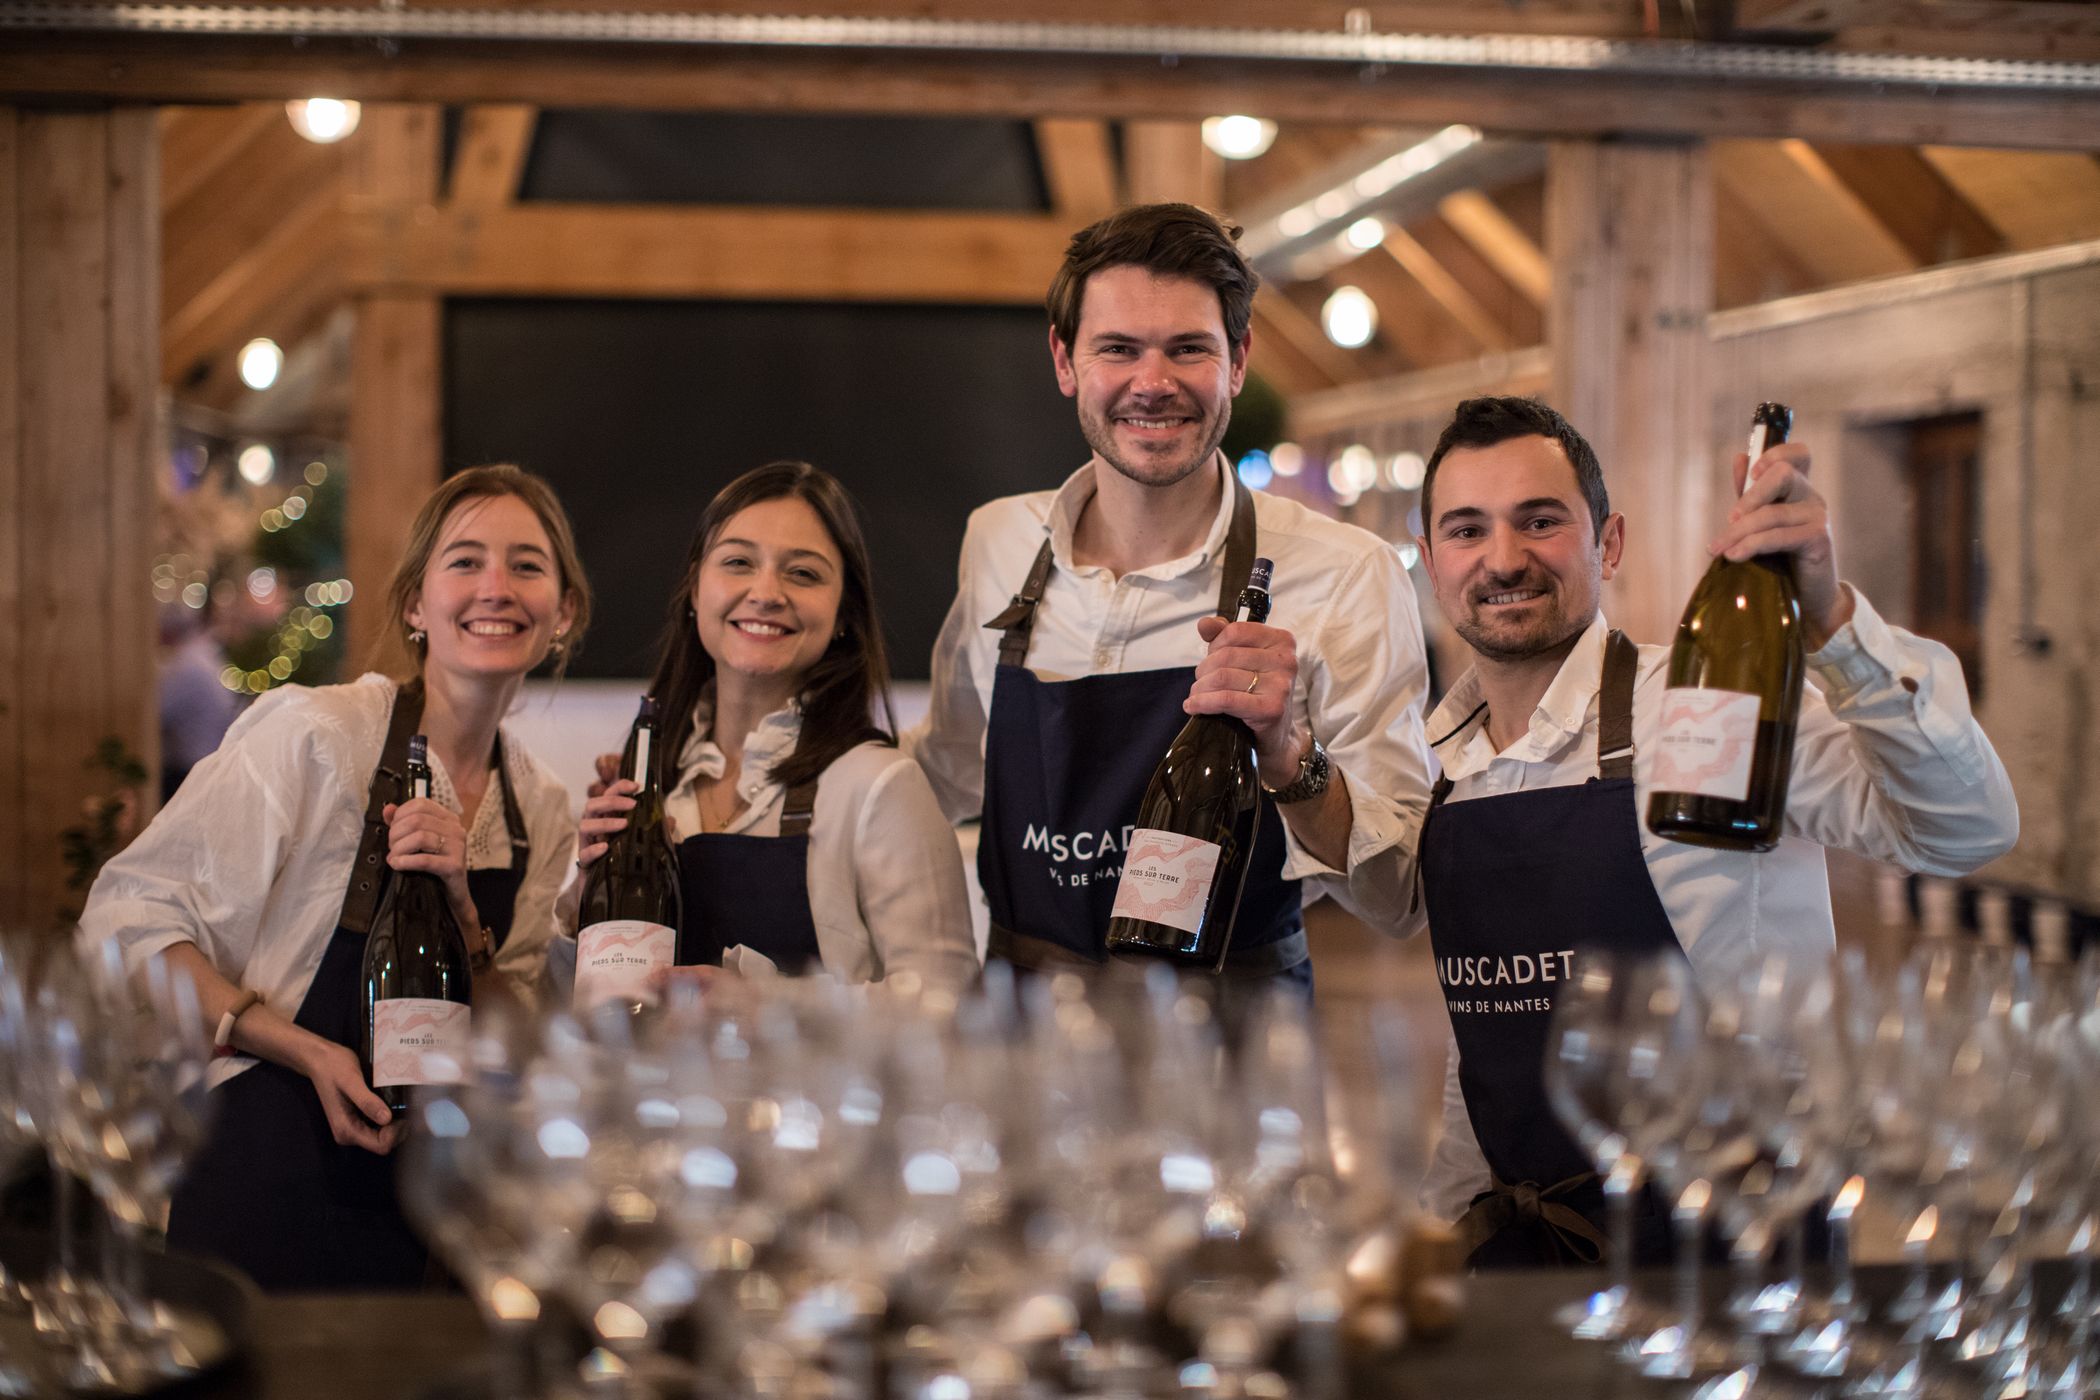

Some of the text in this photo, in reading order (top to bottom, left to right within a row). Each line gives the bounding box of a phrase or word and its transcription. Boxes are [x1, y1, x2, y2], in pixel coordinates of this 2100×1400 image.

[1071, 874, 1089, 887] DE
[1145, 871, 1158, 879] SUR
[1159, 873, 1180, 884] TERRE
[591, 958, 609, 966] PIEDS
[627, 957, 647, 965] TERRE
[1476, 1000, 1490, 1013] DE
[1495, 997, 1550, 1013] NANTES
